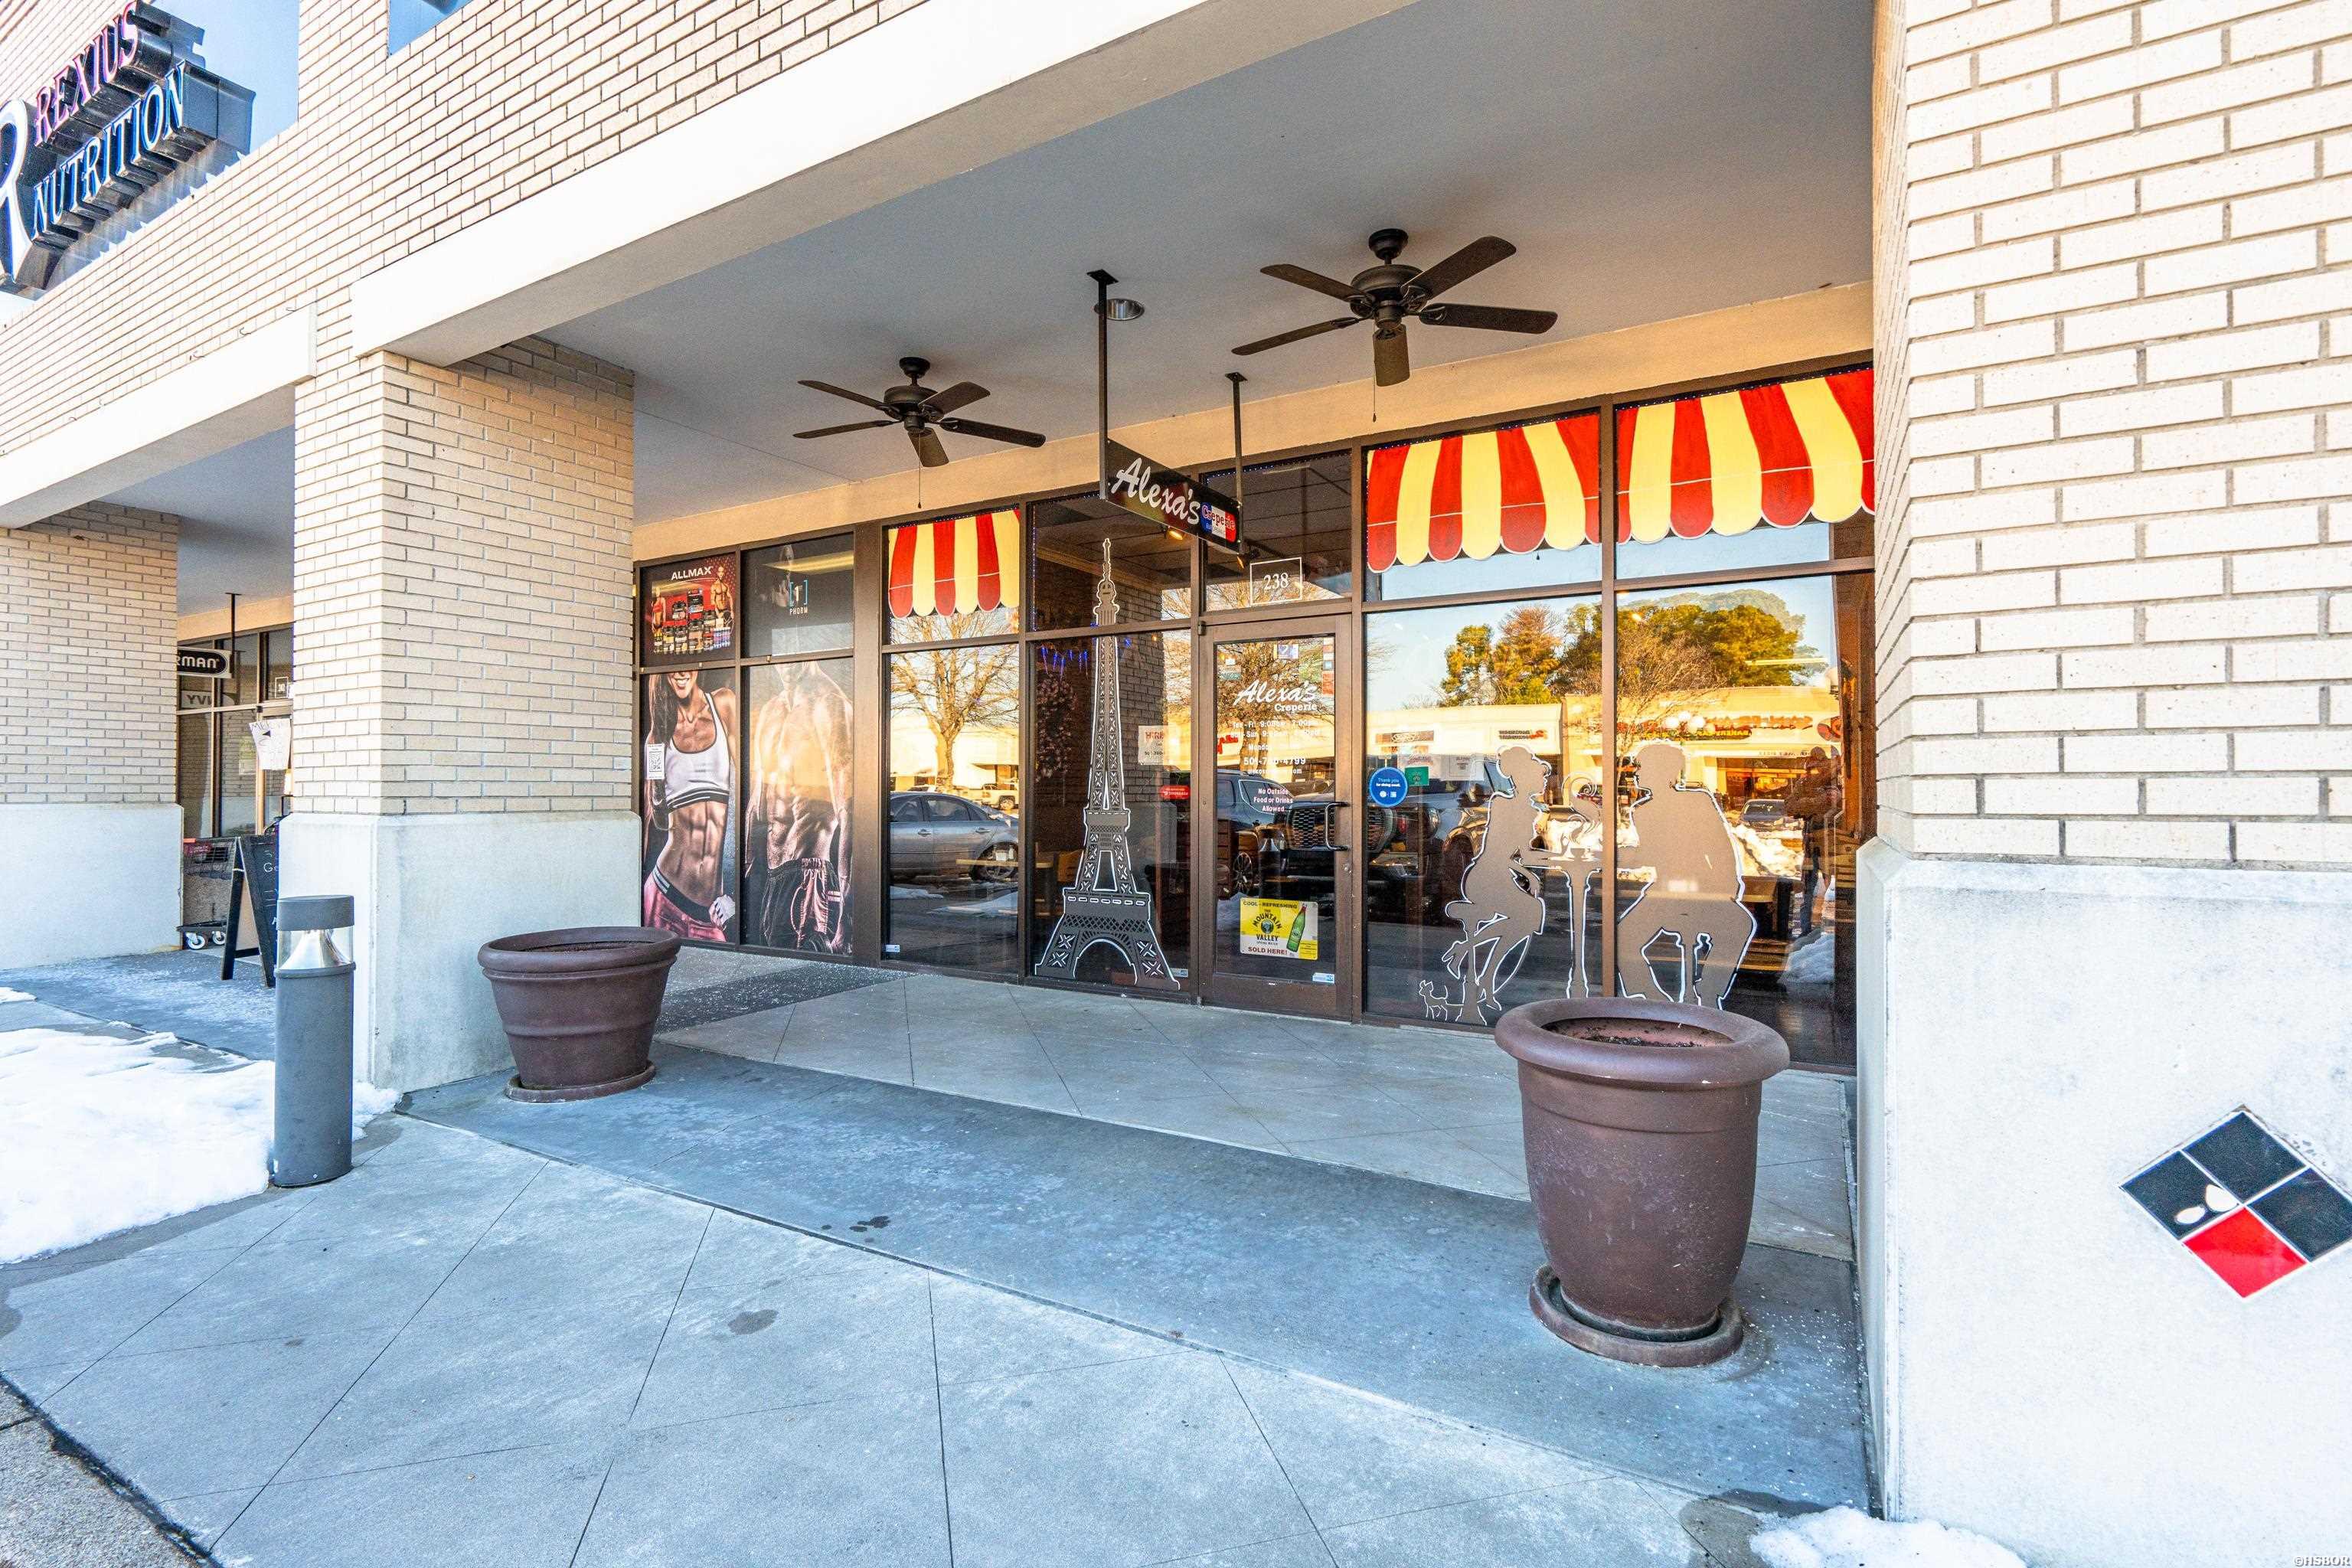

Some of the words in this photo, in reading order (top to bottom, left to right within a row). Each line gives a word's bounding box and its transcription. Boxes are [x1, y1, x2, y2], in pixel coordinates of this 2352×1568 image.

[35, 2, 139, 146] REXIUS
[31, 60, 186, 240] NUTRITION
[1111, 458, 1200, 524] Alexa's
[671, 567, 711, 580] ALLMAX
[1263, 573, 1289, 590] 238
[1233, 679, 1317, 705] Alexa's
[1274, 704, 1317, 712] Creperie
[1253, 913, 1282, 929] MOUNTAIN
[1256, 933, 1279, 942] VALLEY
